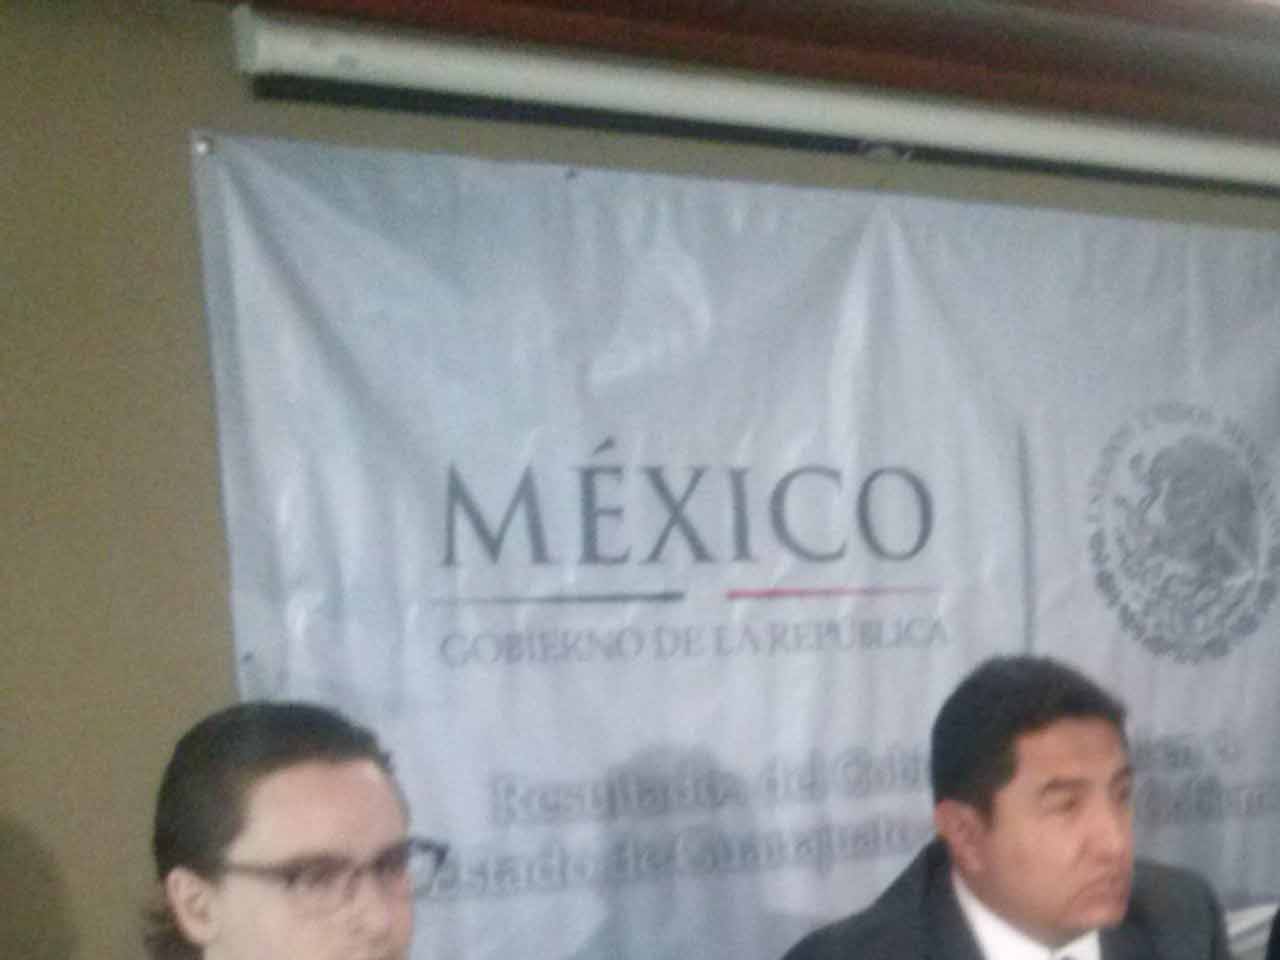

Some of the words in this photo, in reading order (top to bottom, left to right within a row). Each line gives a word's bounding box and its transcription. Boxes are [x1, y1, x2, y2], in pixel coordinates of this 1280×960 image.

[441, 437, 934, 567] MÉXICO
[440, 630, 645, 667] GOBIERNO
[653, 624, 697, 659] DE
[713, 622, 763, 657] LA
